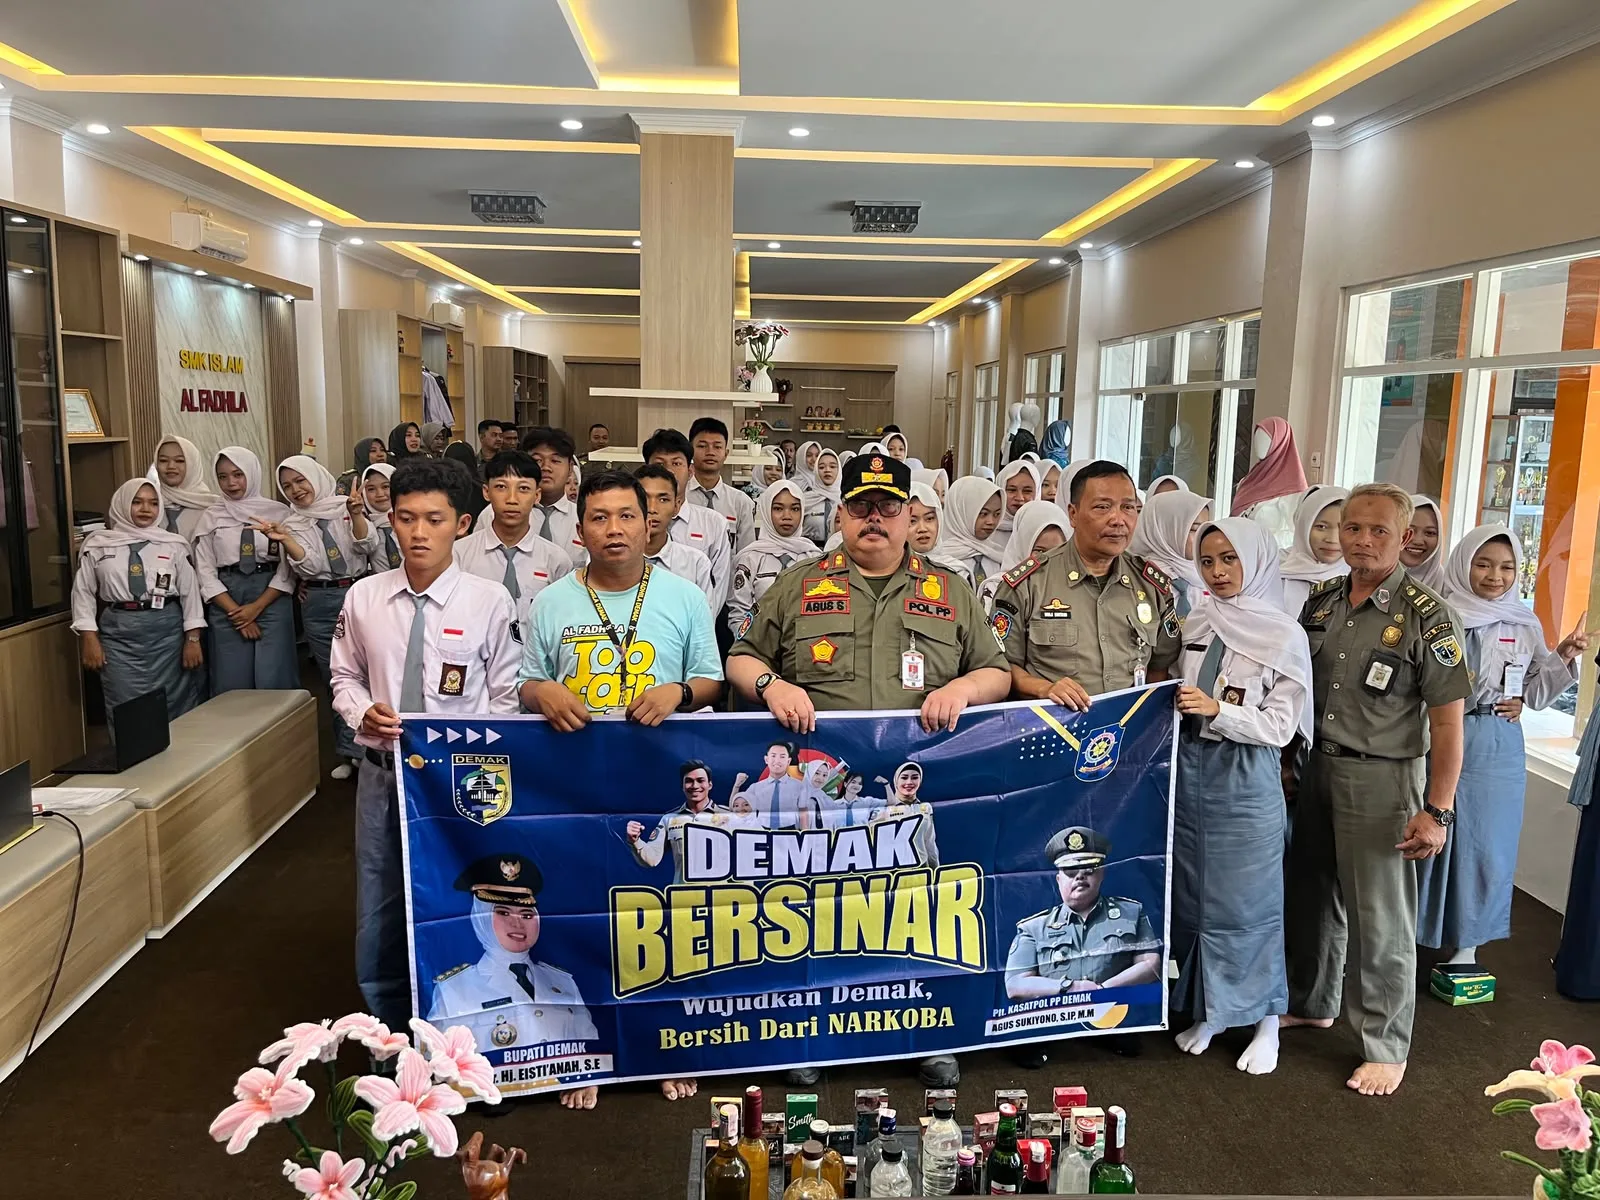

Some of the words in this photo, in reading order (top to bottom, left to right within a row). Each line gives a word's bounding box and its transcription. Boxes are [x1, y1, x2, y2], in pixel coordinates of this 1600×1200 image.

[179, 349, 207, 371] SMK
[208, 353, 244, 374] ISLAM
[181, 388, 199, 412] AL
[198, 389, 248, 413] FADHILA
[836, 600, 845, 611] S
[909, 602, 932, 615] POL
[936, 606, 951, 617] PP
[562, 626, 576, 637] AL
[455, 755, 505, 764] DEMAK
[686, 815, 922, 881] DEMAK
[611, 865, 985, 996] BERSINAR
[683, 989, 822, 1017] Wujudkan
[831, 979, 933, 1004] Demak,
[1008, 998, 1049, 1014] KASATPOL
[1050, 996, 1061, 1006] PP
[1062, 993, 1092, 1005] DEMAK
[659, 1021, 750, 1050] Bersih
[759, 1016, 818, 1041] Dari
[828, 1006, 955, 1035] NARKOBA
[991, 1020, 1014, 1032] AGUS
[1077, 1008, 1095, 1019] M.M
[503, 1045, 544, 1064] BUPATI
[546, 1041, 587, 1057] DEMAK
[501, 1069, 517, 1083] Hj.
[584, 1058, 601, 1071] S.E
